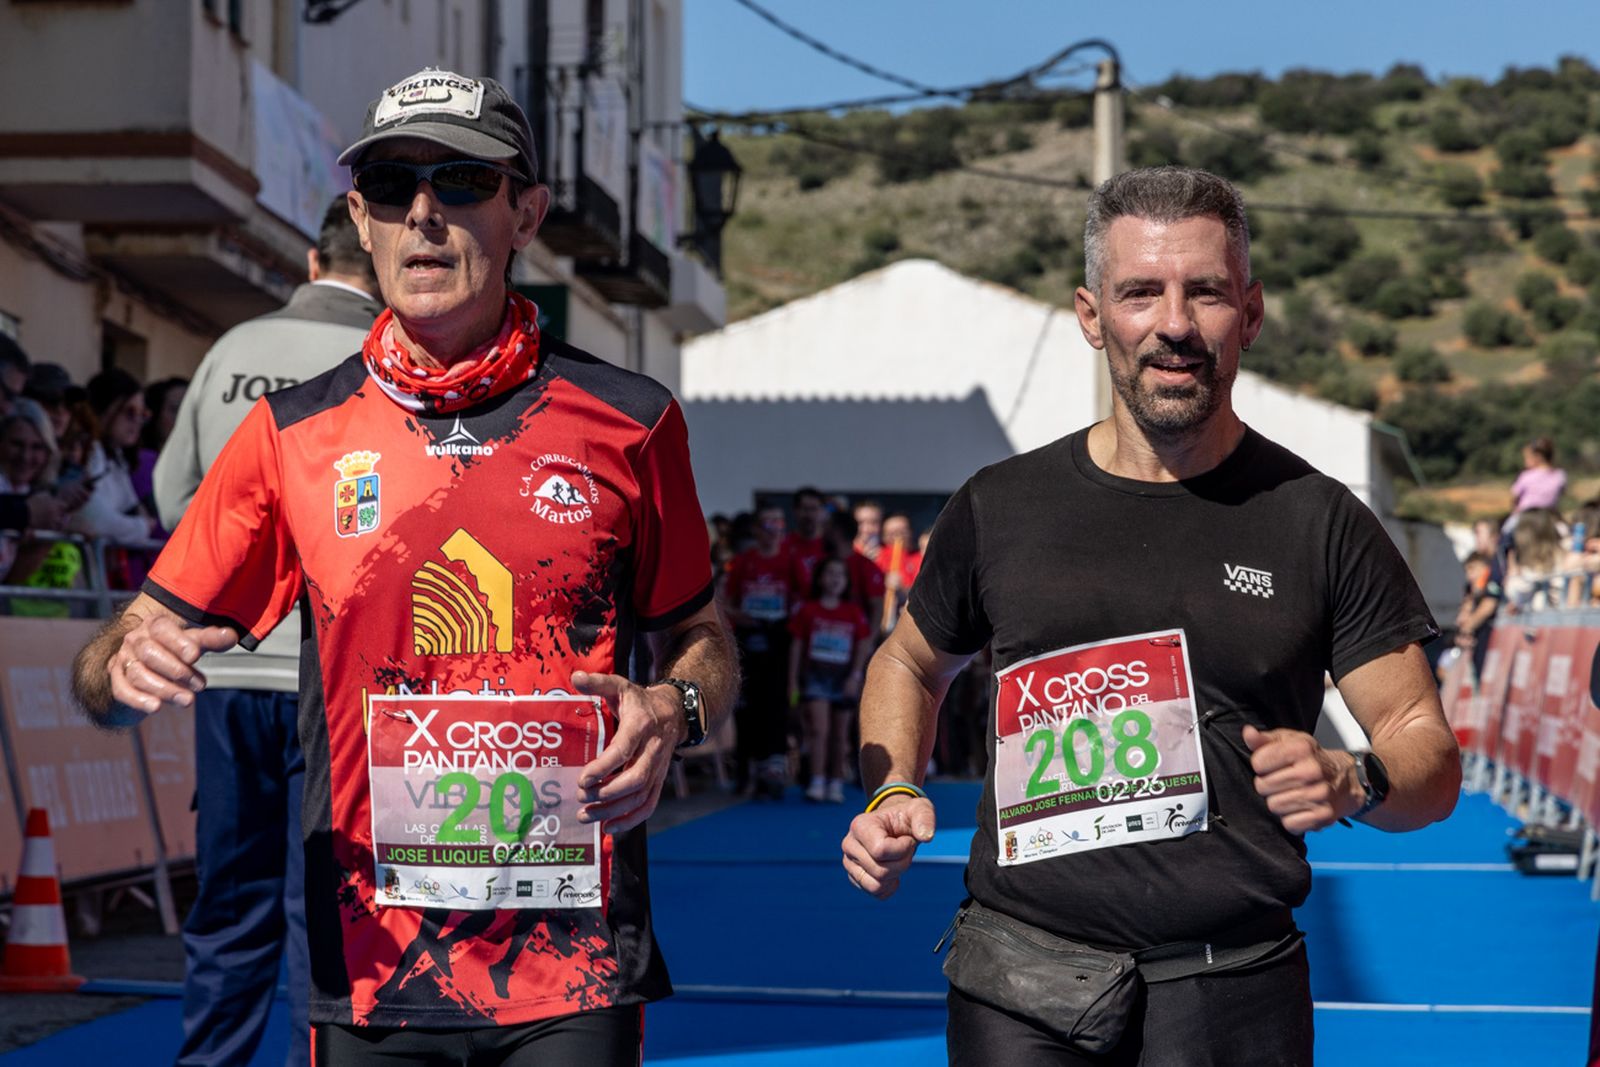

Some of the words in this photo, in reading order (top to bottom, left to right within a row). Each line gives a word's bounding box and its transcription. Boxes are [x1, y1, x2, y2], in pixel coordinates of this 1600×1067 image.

[530, 498, 592, 524] Martos
[1224, 563, 1272, 588] VANS
[1016, 671, 1040, 713] X
[1044, 660, 1150, 704] CROSS
[1019, 693, 1126, 738] PANTANO
[1131, 693, 1154, 706] DEL
[404, 709, 439, 747] X
[446, 721, 563, 749] CROSS
[404, 751, 537, 775] PANTANO
[541, 756, 562, 767] DEL
[1024, 710, 1159, 798] 208
[435, 771, 534, 844] 20
[1000, 804, 1033, 820] ALVARO
[1034, 799, 1057, 812] JOSE
[404, 824, 427, 834] LAS
[387, 847, 428, 863] JOSE
[432, 849, 490, 864] LUQUE
